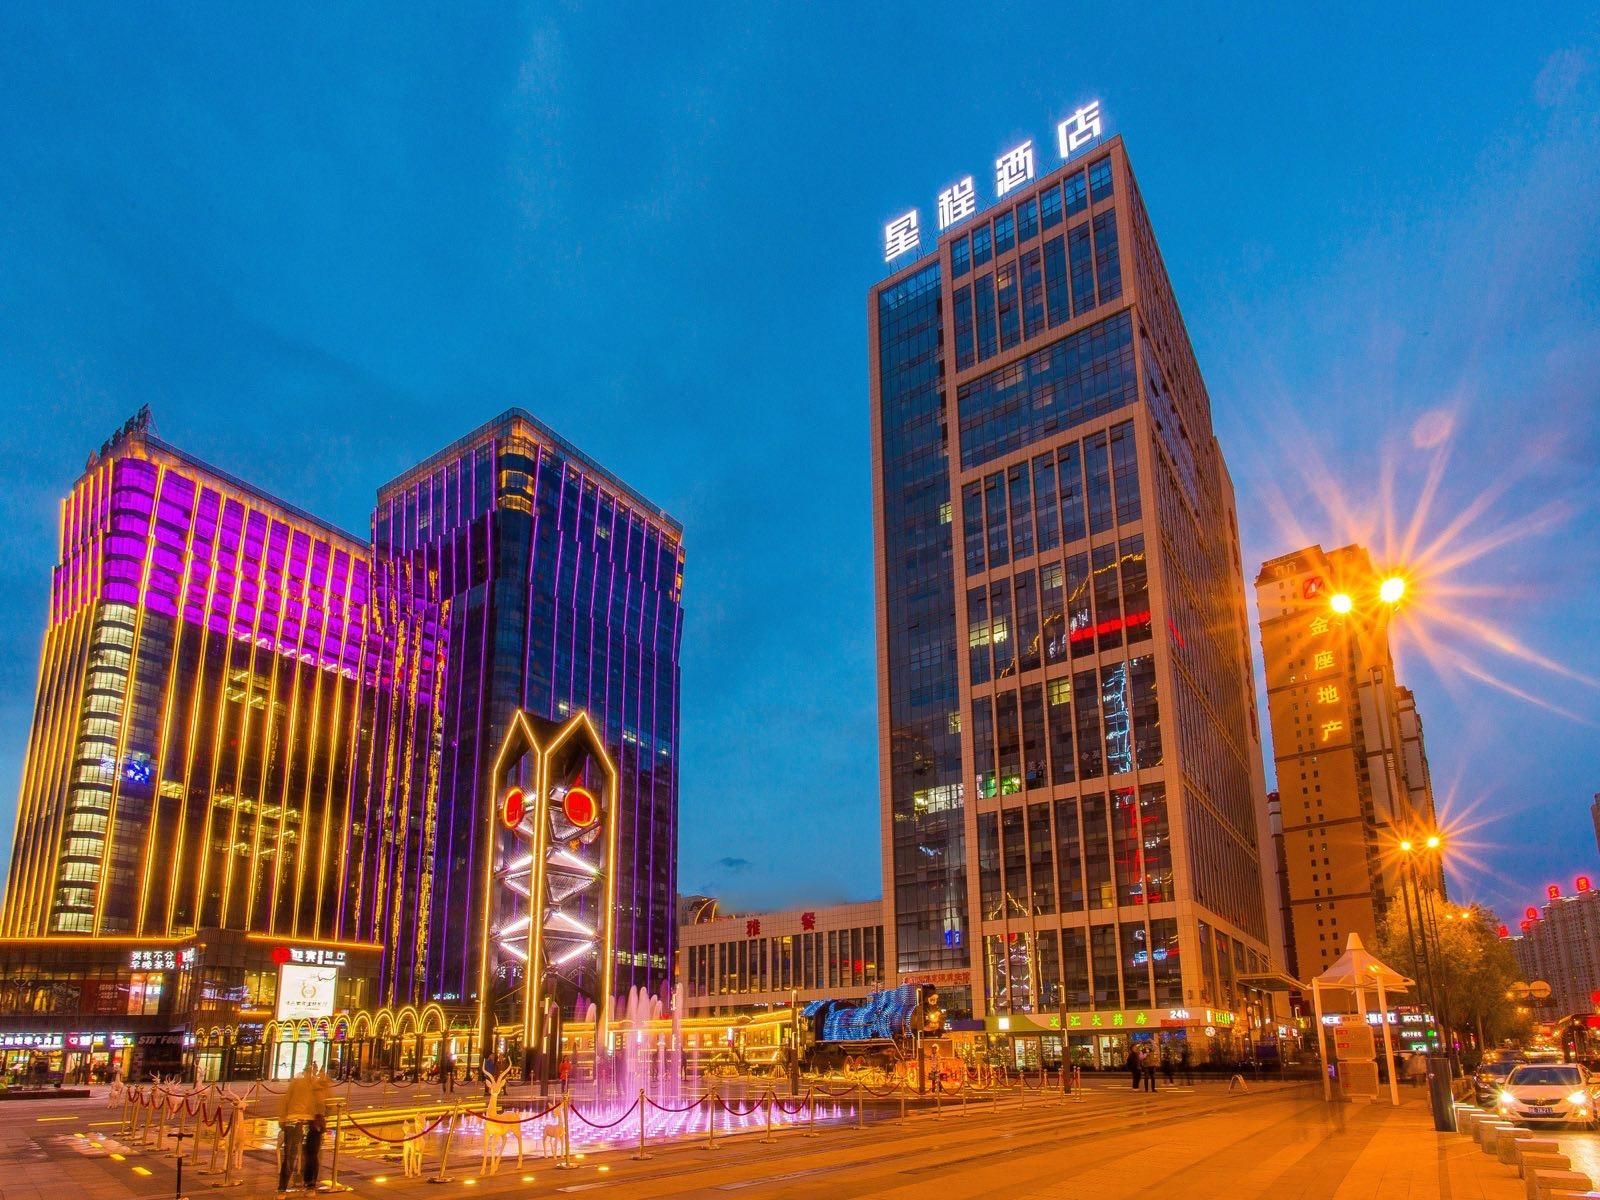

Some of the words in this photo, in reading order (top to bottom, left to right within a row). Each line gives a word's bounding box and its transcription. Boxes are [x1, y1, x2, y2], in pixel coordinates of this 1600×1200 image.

[885, 100, 1100, 262] 星程酒店
[1309, 616, 1343, 741] 金座地产
[1170, 1010, 1189, 1019] 24h
